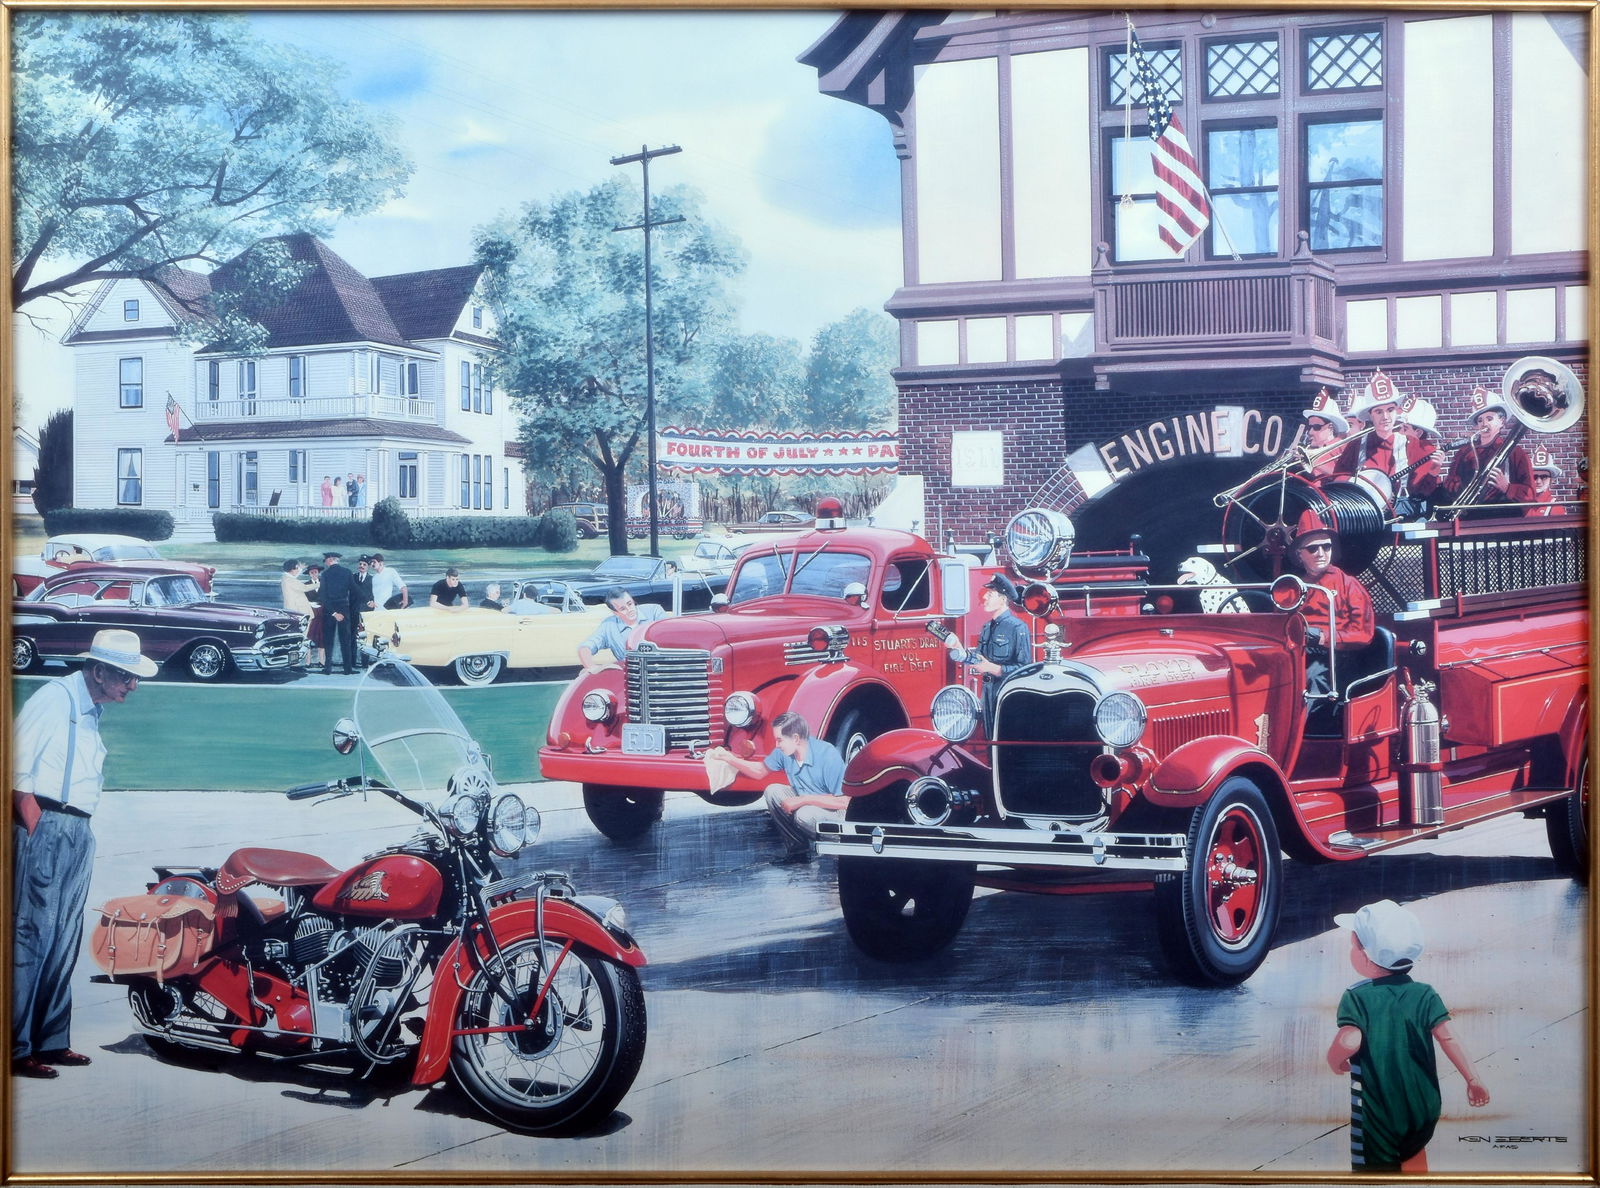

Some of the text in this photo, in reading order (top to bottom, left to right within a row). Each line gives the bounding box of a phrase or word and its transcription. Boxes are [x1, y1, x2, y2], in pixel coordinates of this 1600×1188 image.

[1375, 379, 1388, 395] 6
[1312, 396, 1322, 408] 6
[1474, 392, 1483, 405] 6
[666, 441, 741, 459] FOURTH
[746, 447, 769, 459] OF
[773, 447, 819, 459] JULY
[1099, 410, 1232, 479] ENGINE
[1536, 451, 1546, 463] 6
[873, 638, 917, 651] STUART'S
[883, 660, 934, 673] FIRE DEPT
